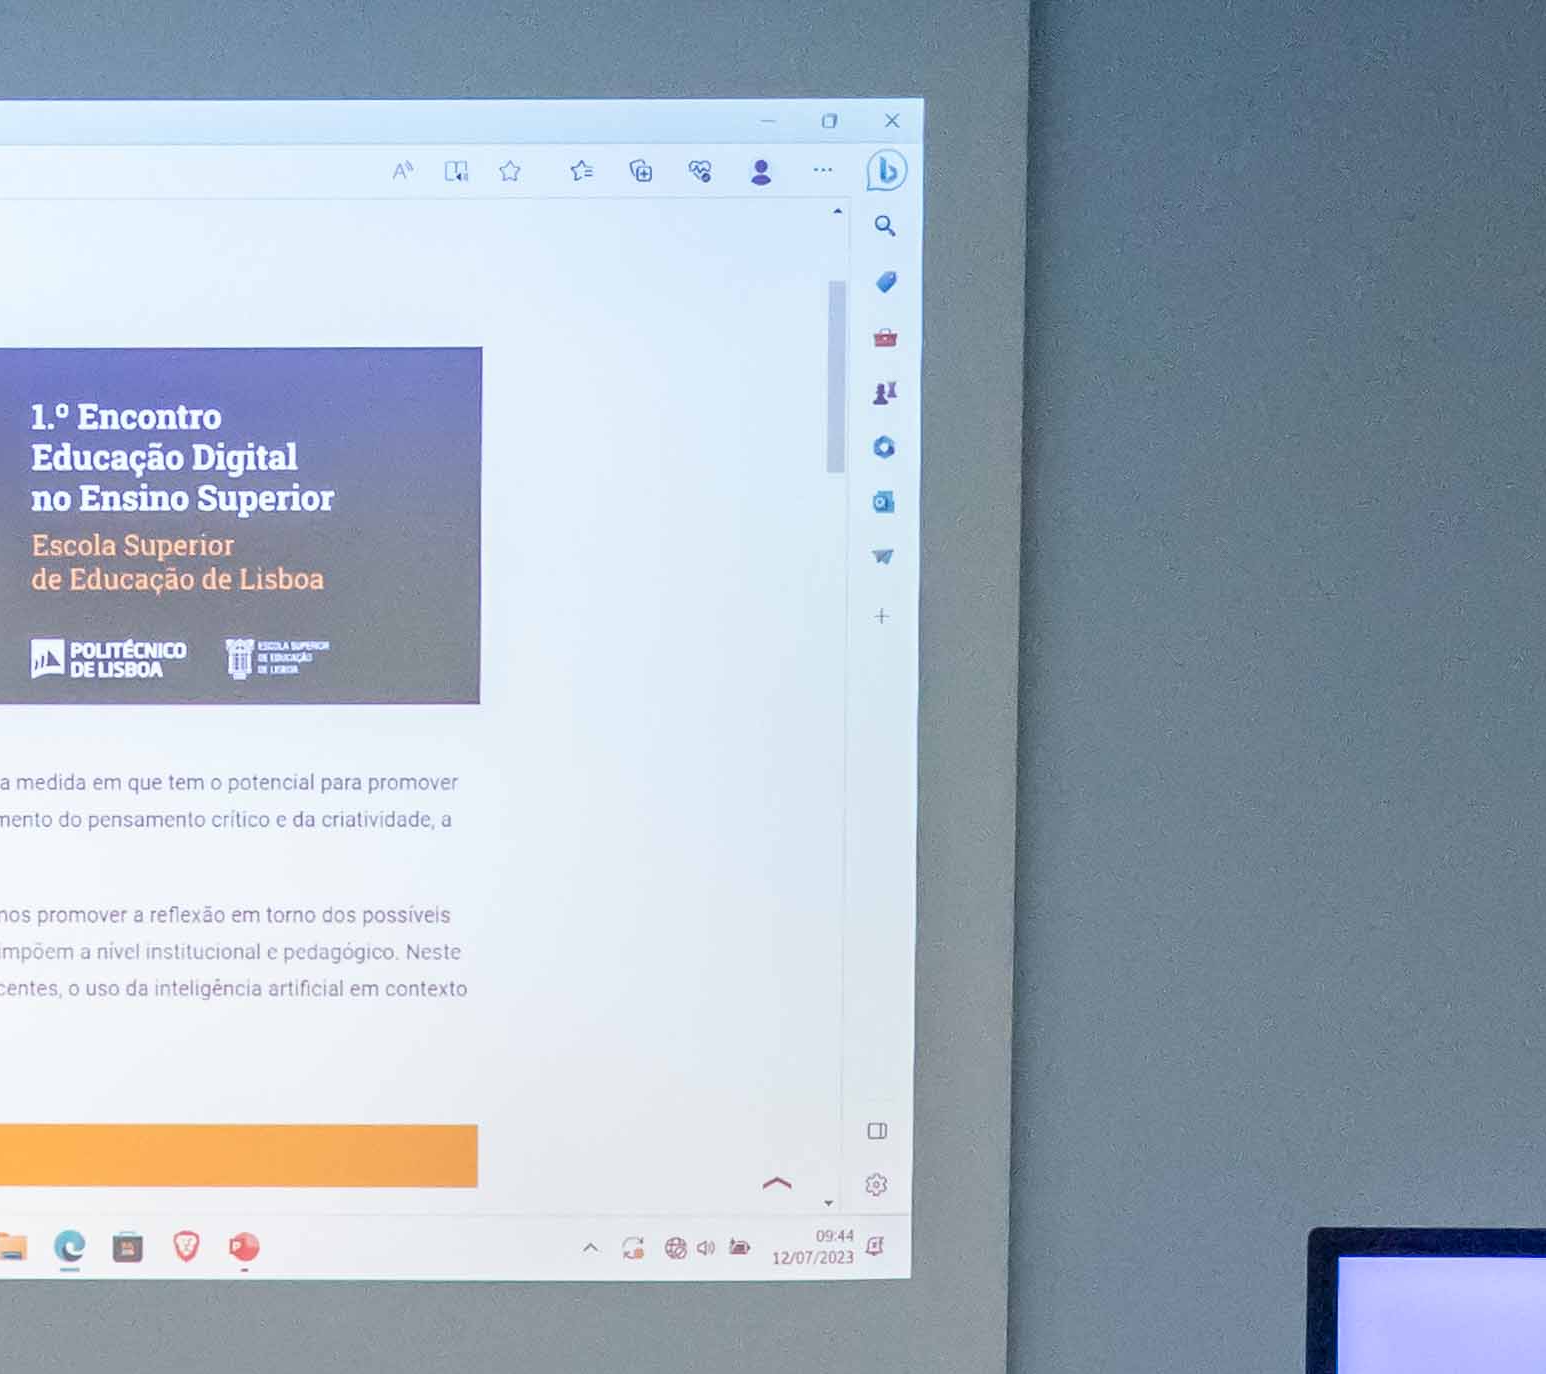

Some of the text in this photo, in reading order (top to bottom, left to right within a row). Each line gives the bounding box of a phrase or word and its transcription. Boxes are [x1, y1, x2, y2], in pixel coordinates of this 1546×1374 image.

[32, 403, 221, 430] 1.º Encontro
[32, 442, 298, 478] Educação Digital
[31, 483, 335, 518] no Ensino Superior
[32, 533, 235, 562] Escola Superior
[31, 566, 324, 596] de Educação de Lisboa
[71, 639, 187, 659] POLITÉCNICO
[71, 661, 163, 678] DE LISBOA
[17, 773, 86, 791] medida
[93, 777, 121, 791] em
[128, 778, 162, 795] que
[168, 774, 204, 790] tem
[211, 778, 222, 790] o
[228, 773, 314, 794] potencial
[321, 777, 361, 794] para
[368, 777, 458, 794] promover
[59, 811, 82, 827] do
[89, 812, 206, 832] pensamento
[212, 810, 270, 827] crítico
[276, 815, 287, 828] e
[293, 811, 315, 828] da
[322, 810, 435, 830] criatividade,
[441, 815, 452, 827] a
[38, 910, 127, 927] promover
[134, 910, 143, 923] a
[150, 906, 225, 923] reflexão
[232, 910, 260, 923] em
[266, 907, 316, 923] torno
[322, 907, 356, 923] dos
[364, 906, 450, 927] possíveis
[816, 1229, 854, 1242] 09:44
[773, 1250, 854, 1264] 12/07/2023
